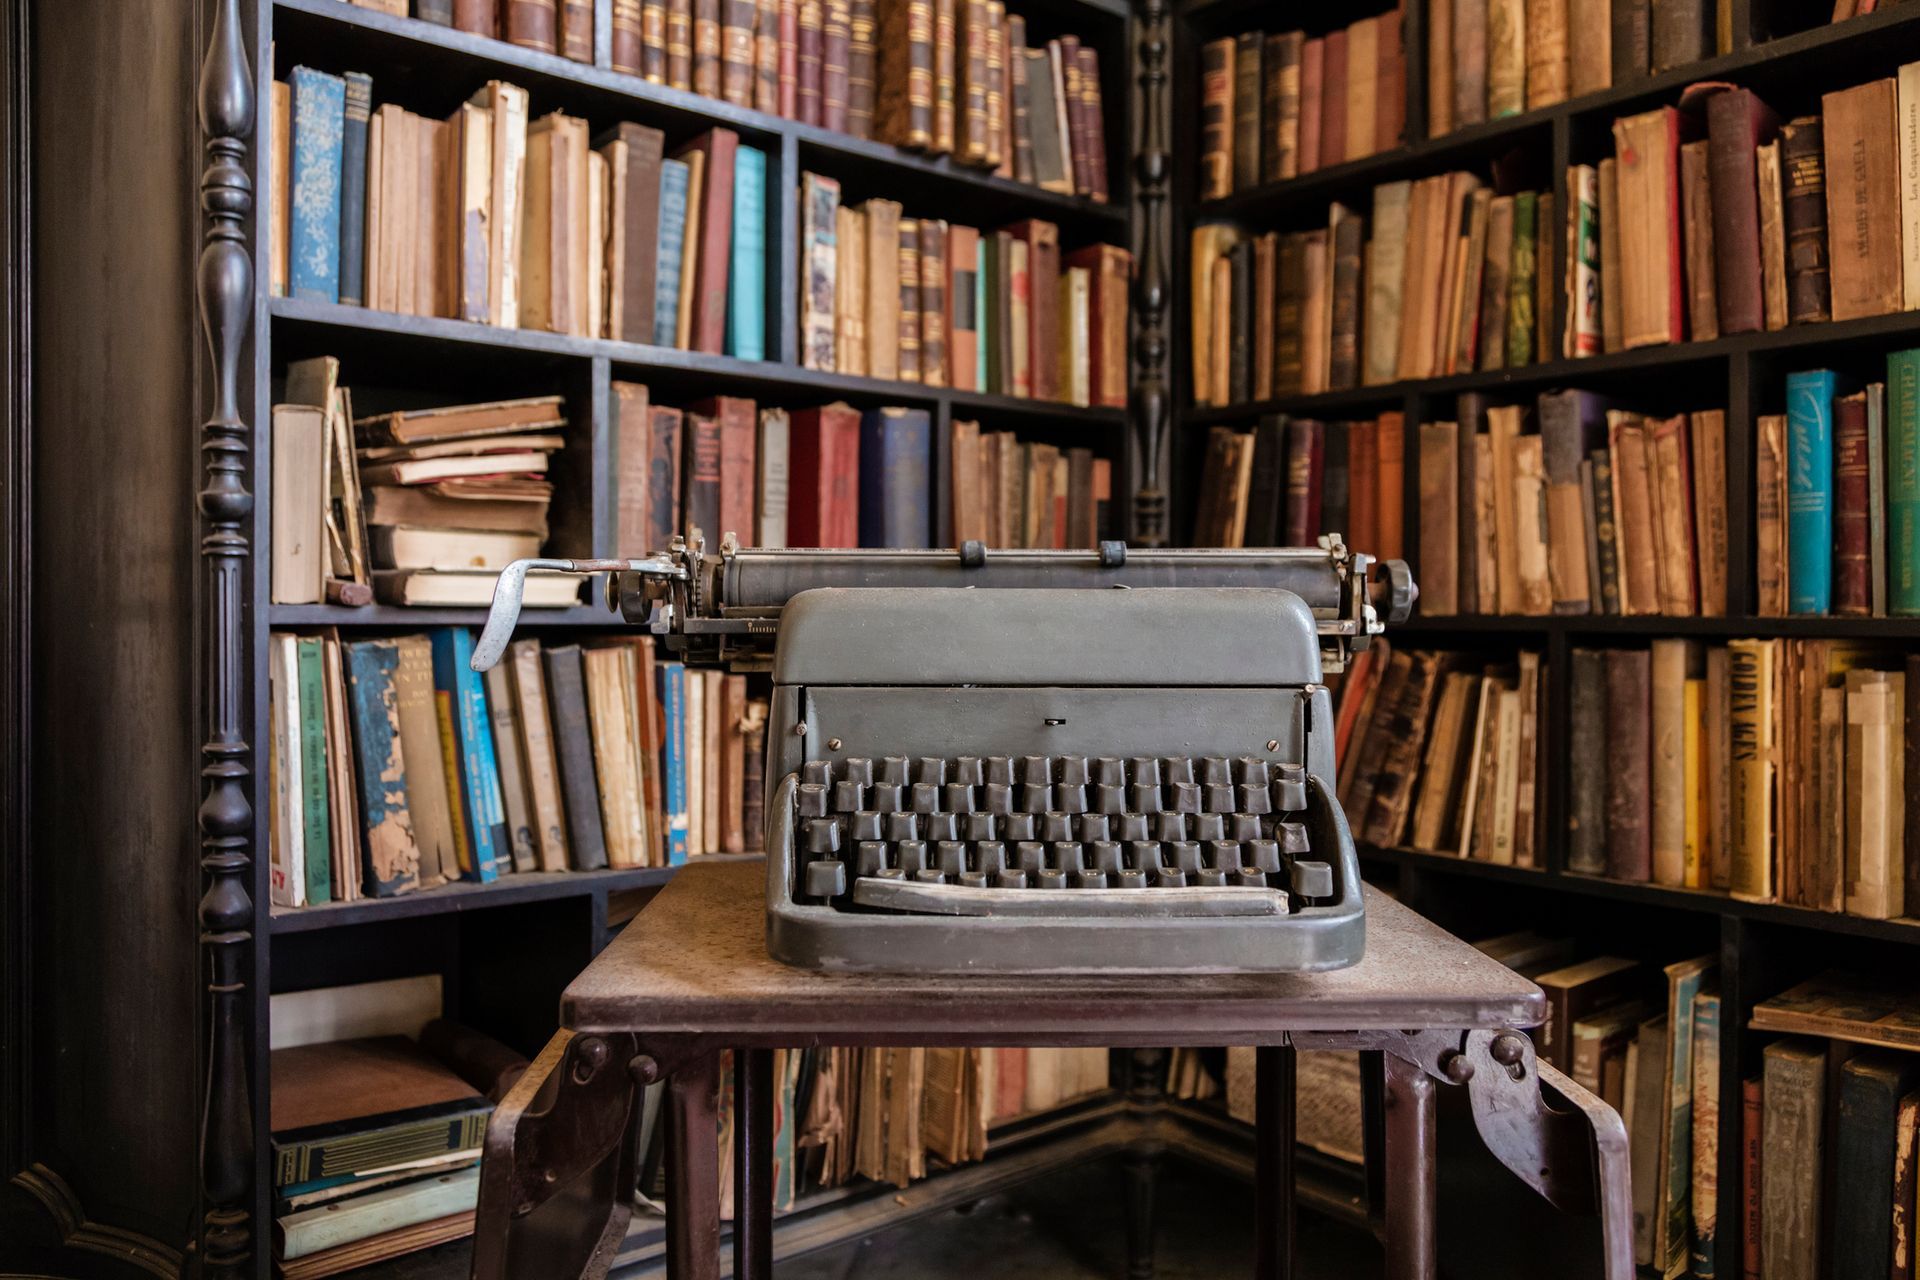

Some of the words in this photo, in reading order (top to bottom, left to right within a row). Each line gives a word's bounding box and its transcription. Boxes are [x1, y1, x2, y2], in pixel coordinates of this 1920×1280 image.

[1908, 103, 1919, 179] Conquistadores
[1855, 187, 1867, 205] DE
[1908, 183, 1918, 201] Los
[1732, 652, 1758, 713] GOLDEN
